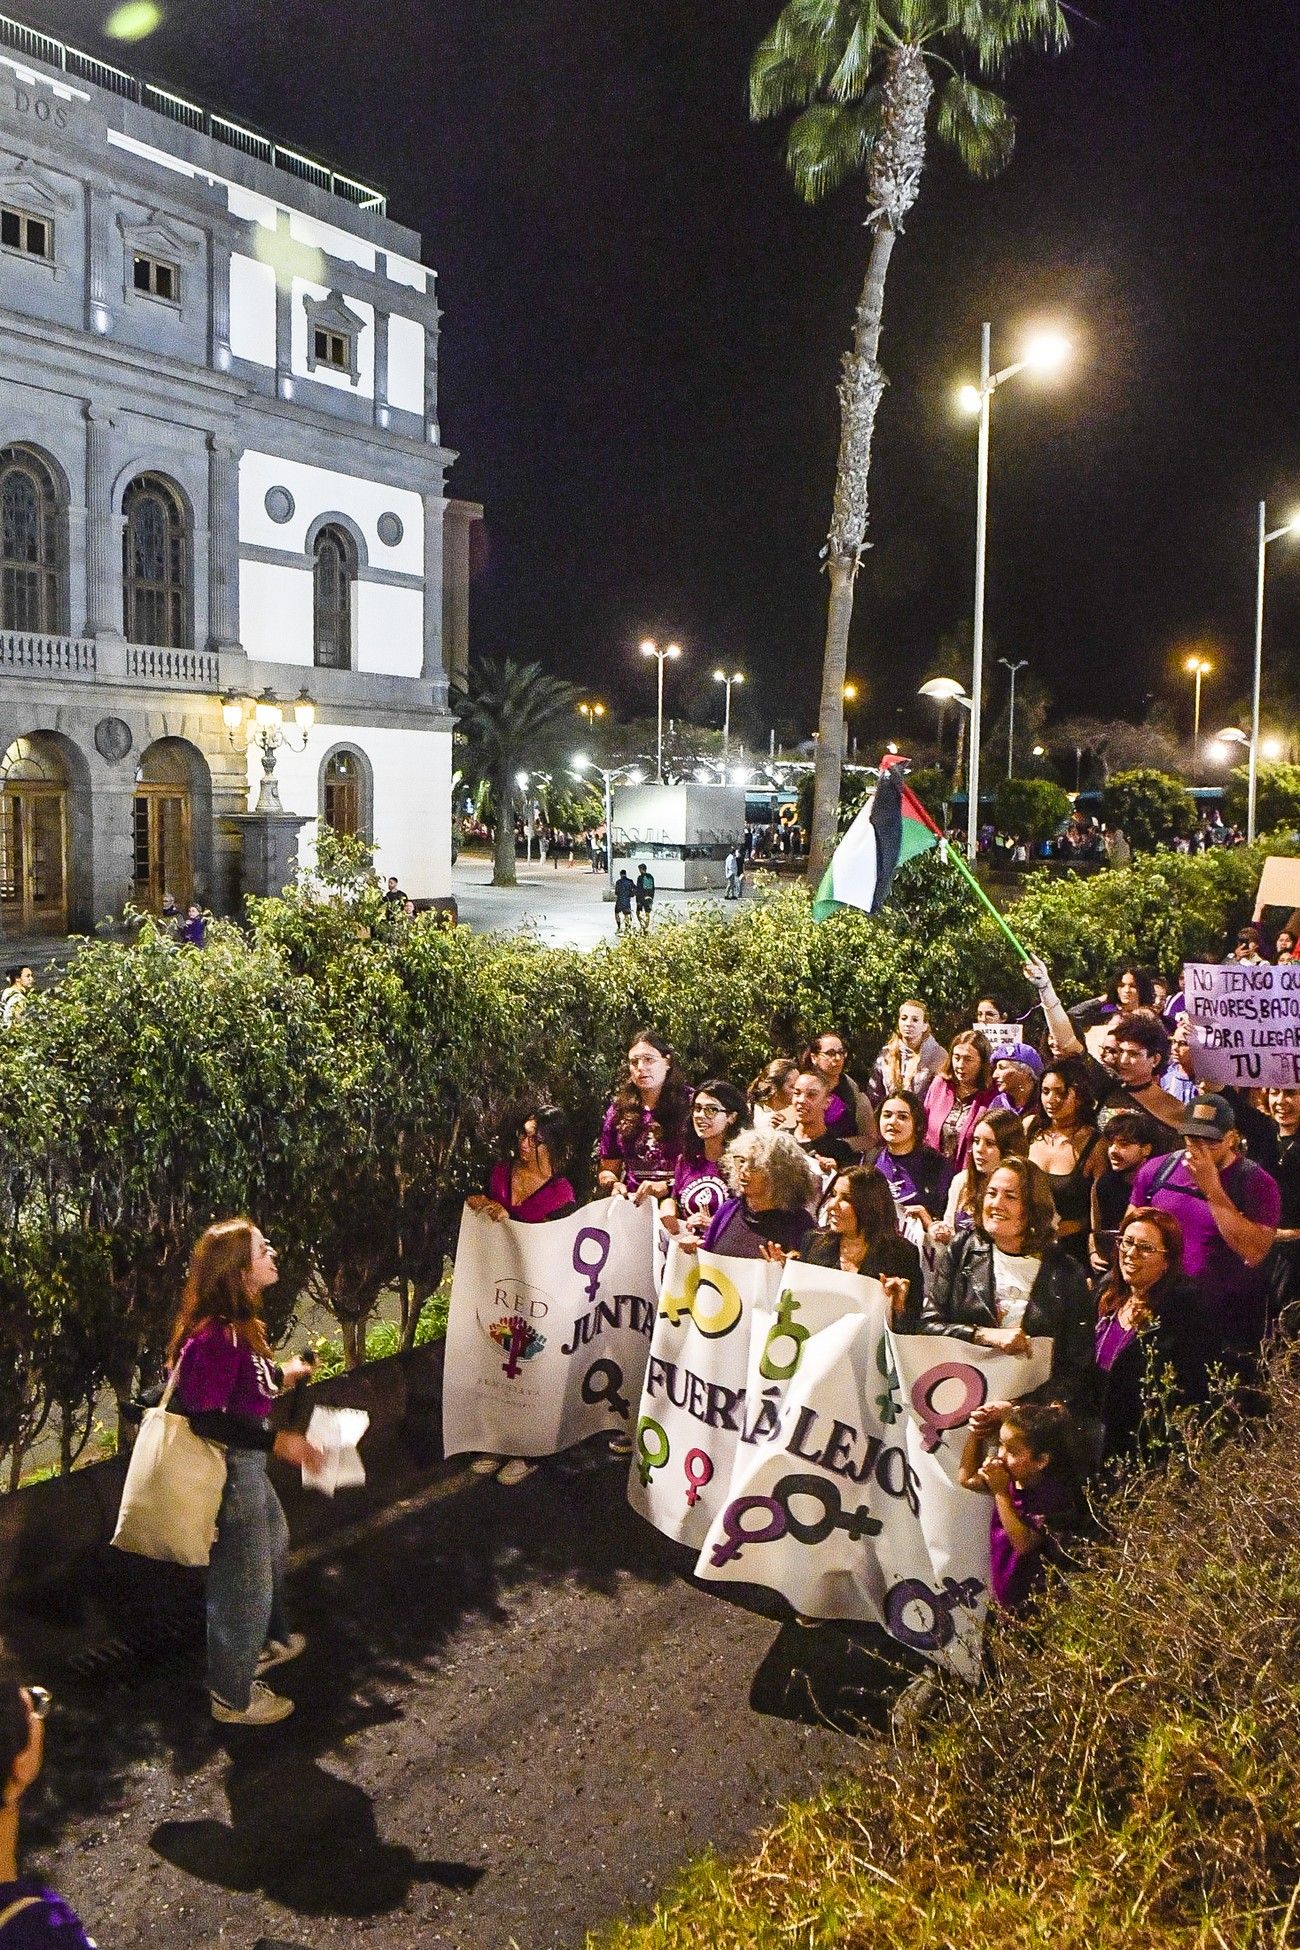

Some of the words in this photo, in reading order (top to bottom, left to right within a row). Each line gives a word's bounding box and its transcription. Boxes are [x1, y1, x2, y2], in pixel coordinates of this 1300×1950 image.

[1193, 968, 1213, 992] NO
[1220, 970, 1274, 993] TENGO
[1203, 1025, 1245, 1050] PARA
[1229, 1053, 1261, 1079] TU
[493, 1287, 549, 1319] RED
